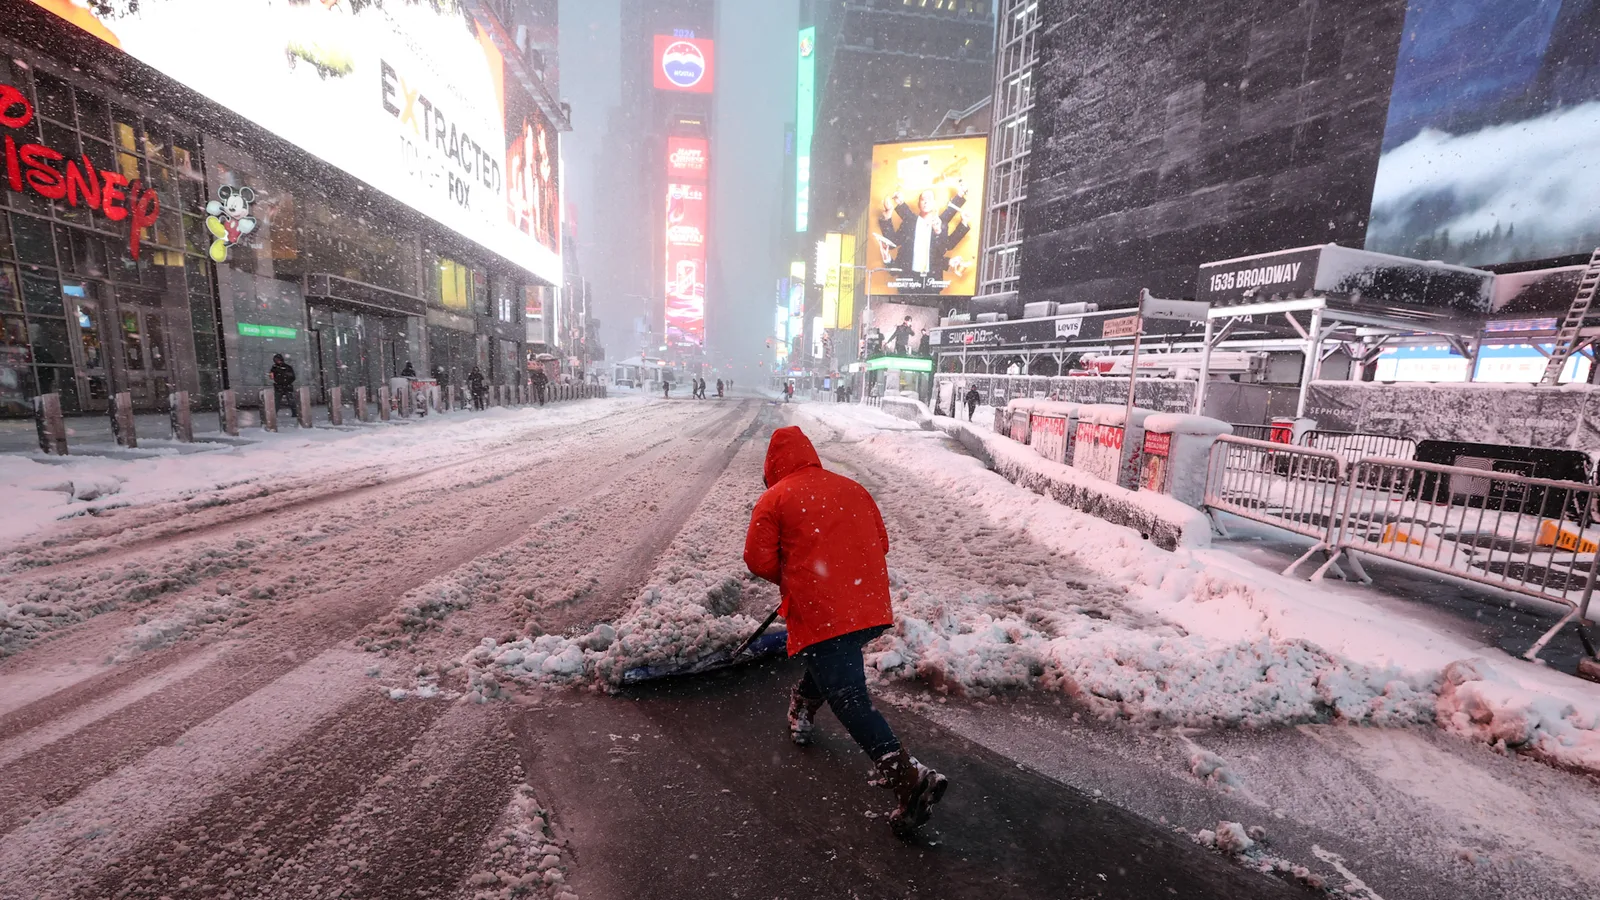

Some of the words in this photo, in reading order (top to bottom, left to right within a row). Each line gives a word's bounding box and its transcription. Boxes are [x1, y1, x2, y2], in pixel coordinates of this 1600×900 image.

[673, 28, 695, 38] 2026
[380, 58, 501, 195] EXTRACTED
[448, 171, 470, 212] FOX
[1210, 272, 1235, 292] 1535
[1236, 262, 1301, 288] BROADWAY
[1309, 406, 1353, 416] SEPHORA
[1032, 415, 1065, 437] CHICAGO
[1077, 423, 1124, 450] CHICAGO
